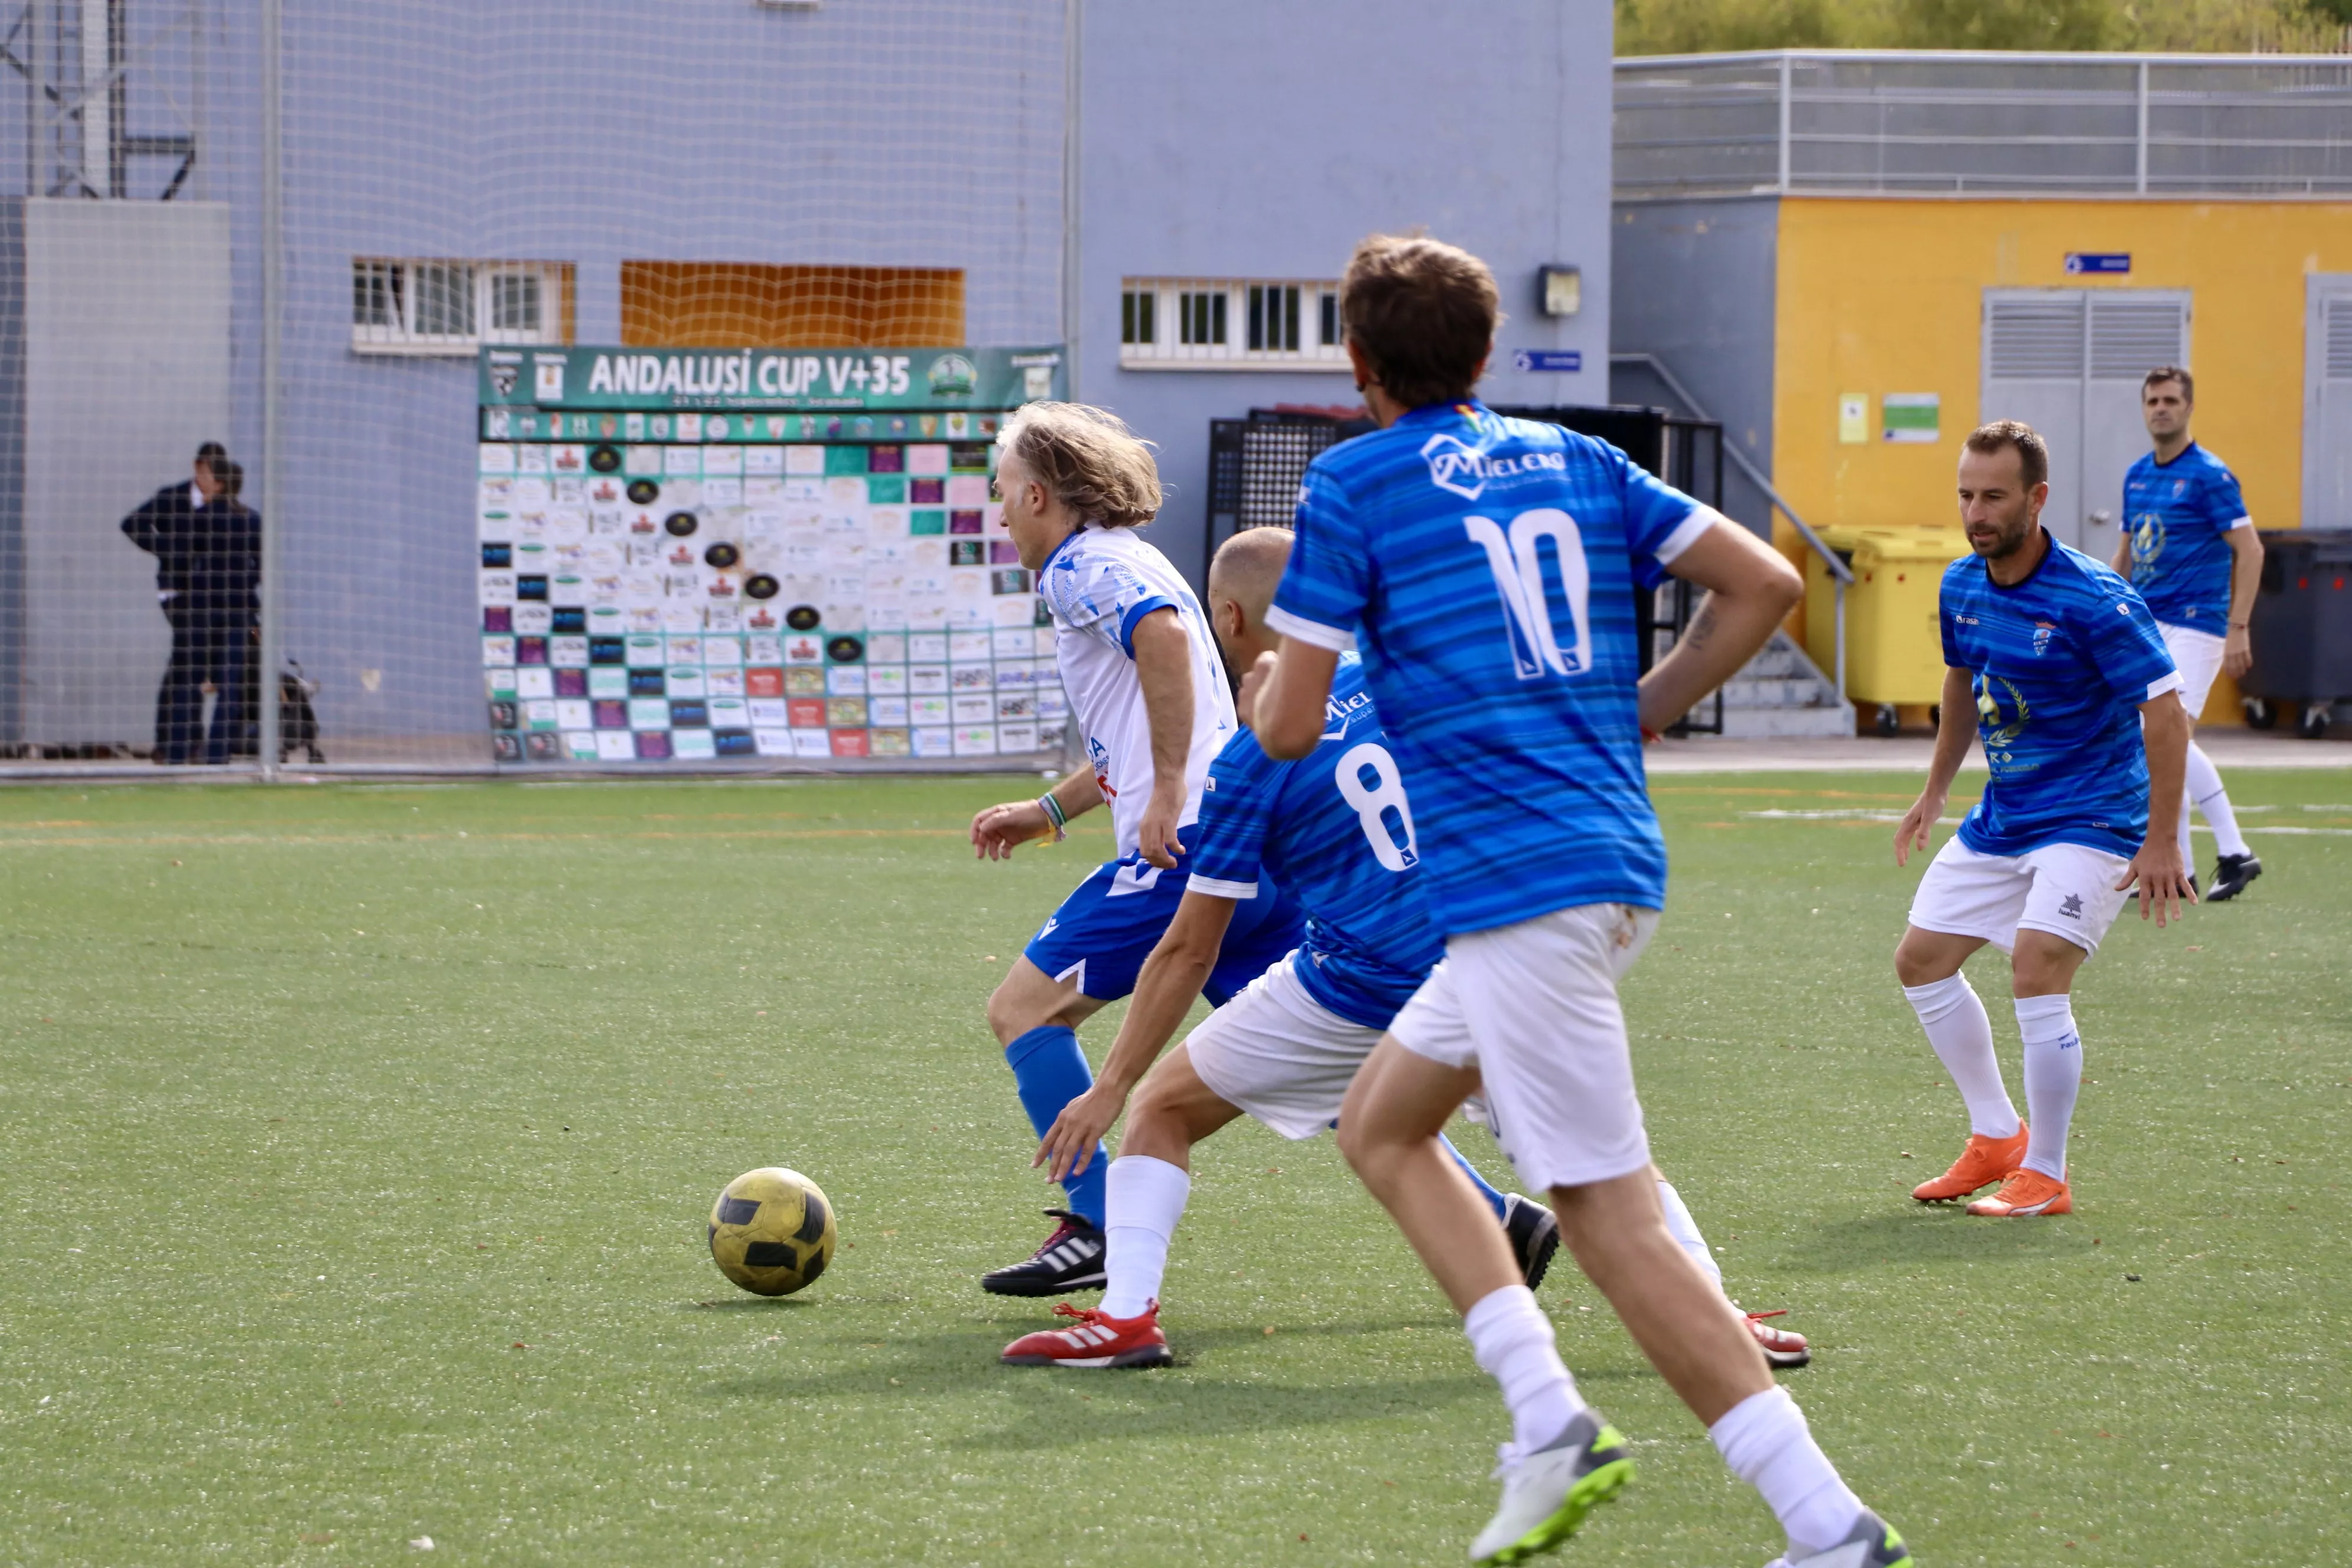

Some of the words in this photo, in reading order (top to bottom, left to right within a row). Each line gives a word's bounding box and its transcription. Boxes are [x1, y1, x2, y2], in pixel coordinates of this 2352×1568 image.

[757, 355, 821, 395] CUP
[828, 355, 911, 395] V+35
[1462, 508, 1592, 681] 10
[1335, 743, 1420, 871] 8
[2058, 907, 2081, 920] luanvi
